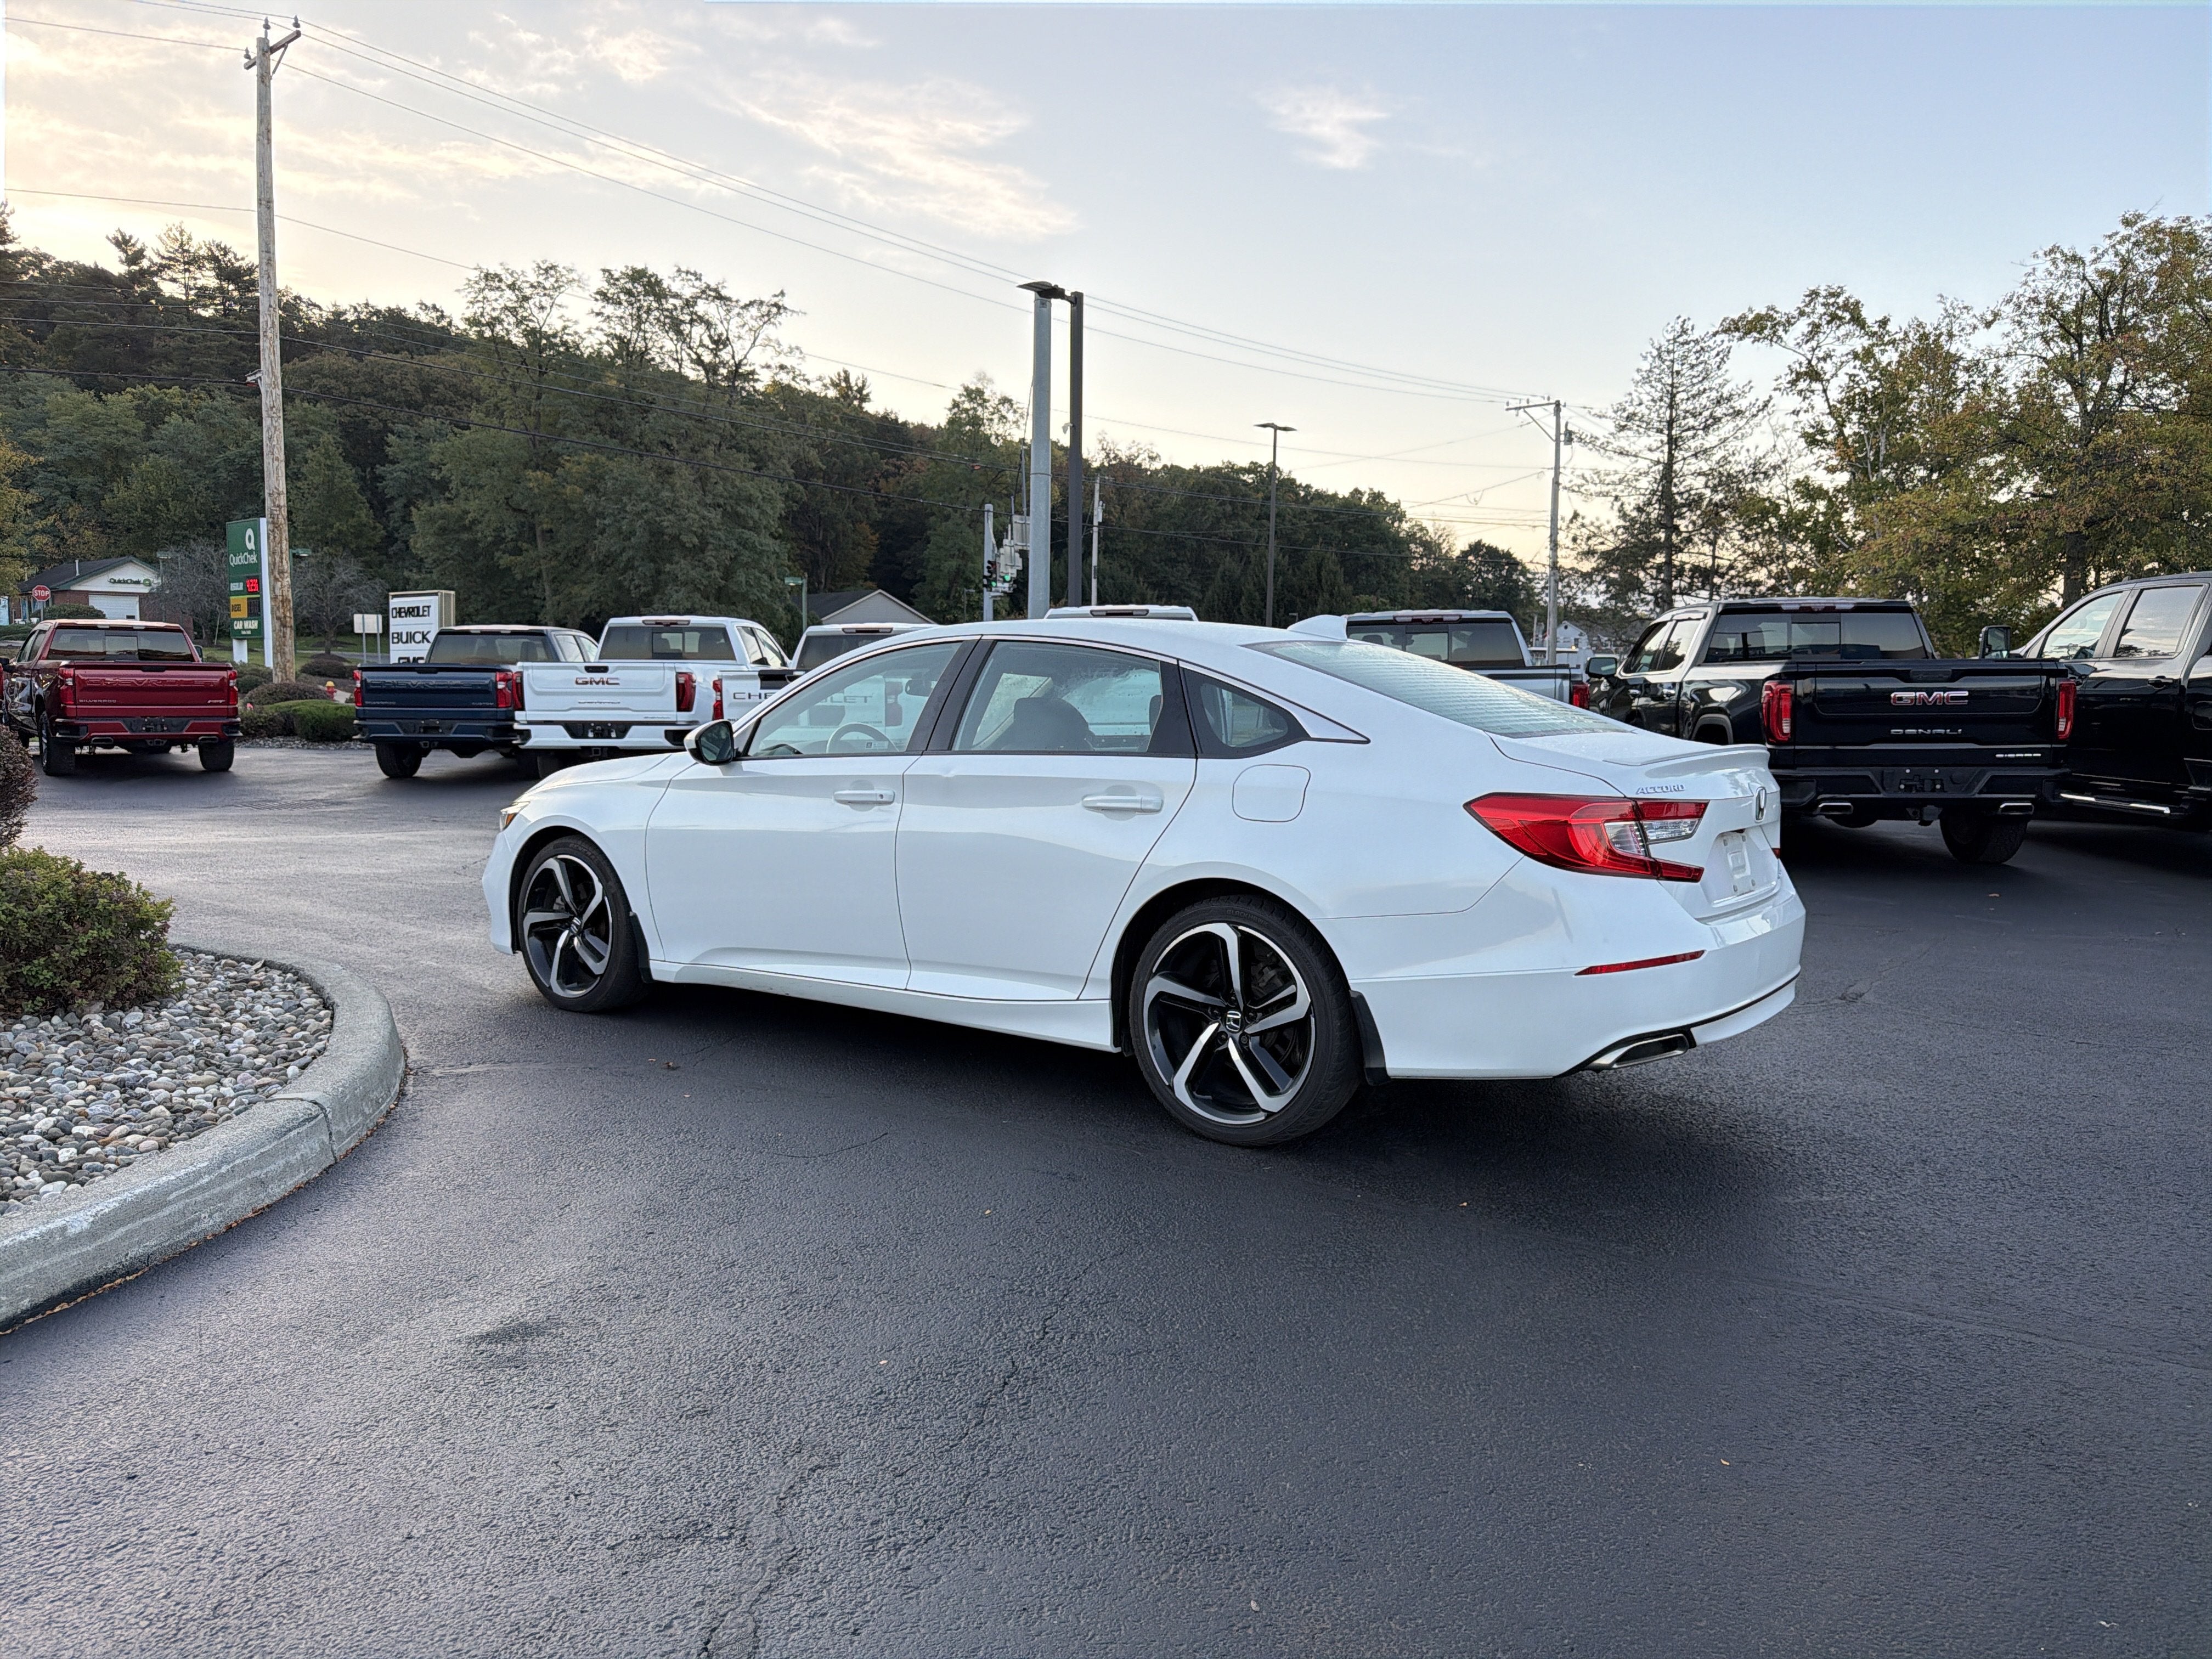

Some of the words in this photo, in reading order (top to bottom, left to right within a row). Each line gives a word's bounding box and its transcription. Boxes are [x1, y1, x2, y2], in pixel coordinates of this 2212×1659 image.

[229, 551, 258, 567] QuickChek
[391, 605, 432, 619] CHEVROLET
[233, 620, 243, 630] CAR
[244, 620, 258, 629] WASH
[391, 630, 432, 644] BUICK
[575, 677, 620, 685] GMC
[1891, 691, 1968, 706] GMC
[1635, 784, 1685, 795] ACCORD
